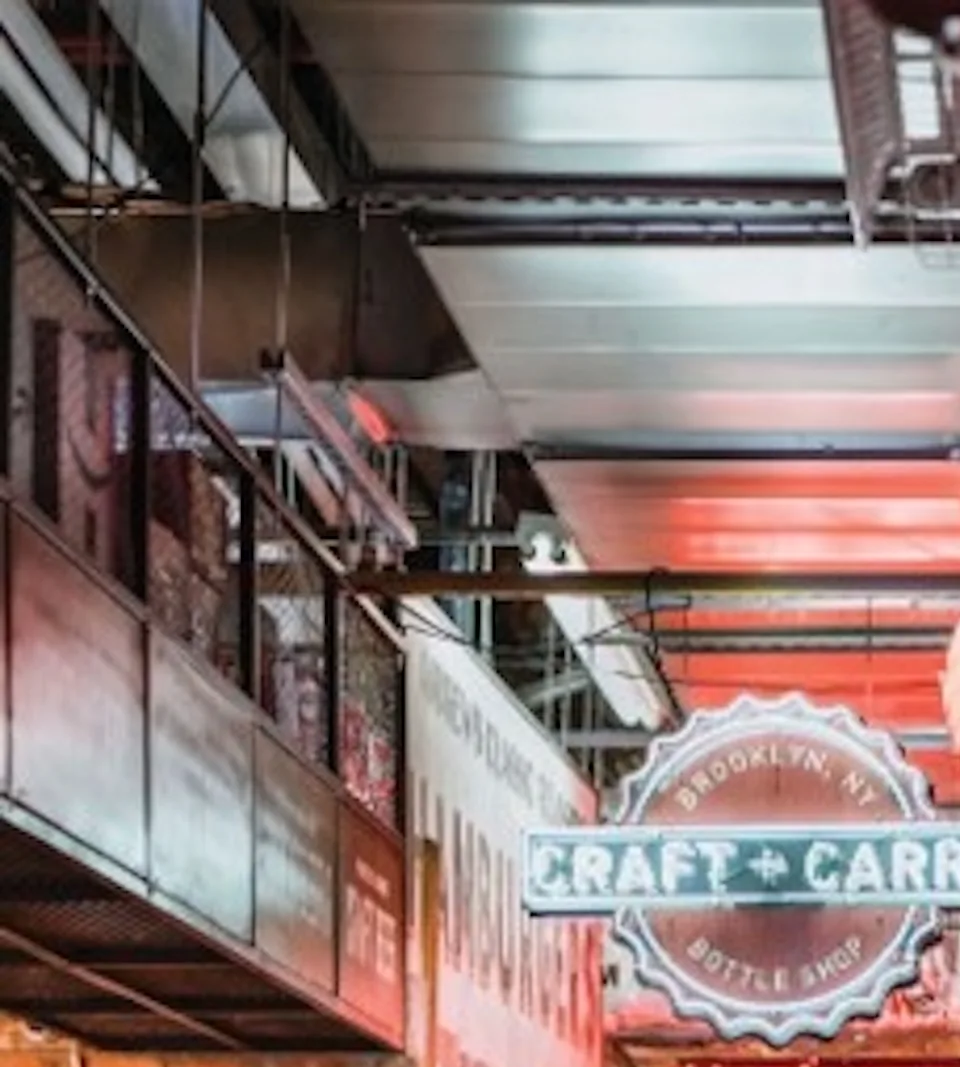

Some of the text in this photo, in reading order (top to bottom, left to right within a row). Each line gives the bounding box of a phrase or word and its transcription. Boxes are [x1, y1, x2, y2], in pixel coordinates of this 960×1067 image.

[675, 742, 876, 812] BROOKLYN, NY
[533, 842, 738, 895] CRAFT
[686, 937, 862, 991] BOTTLE SHOP
